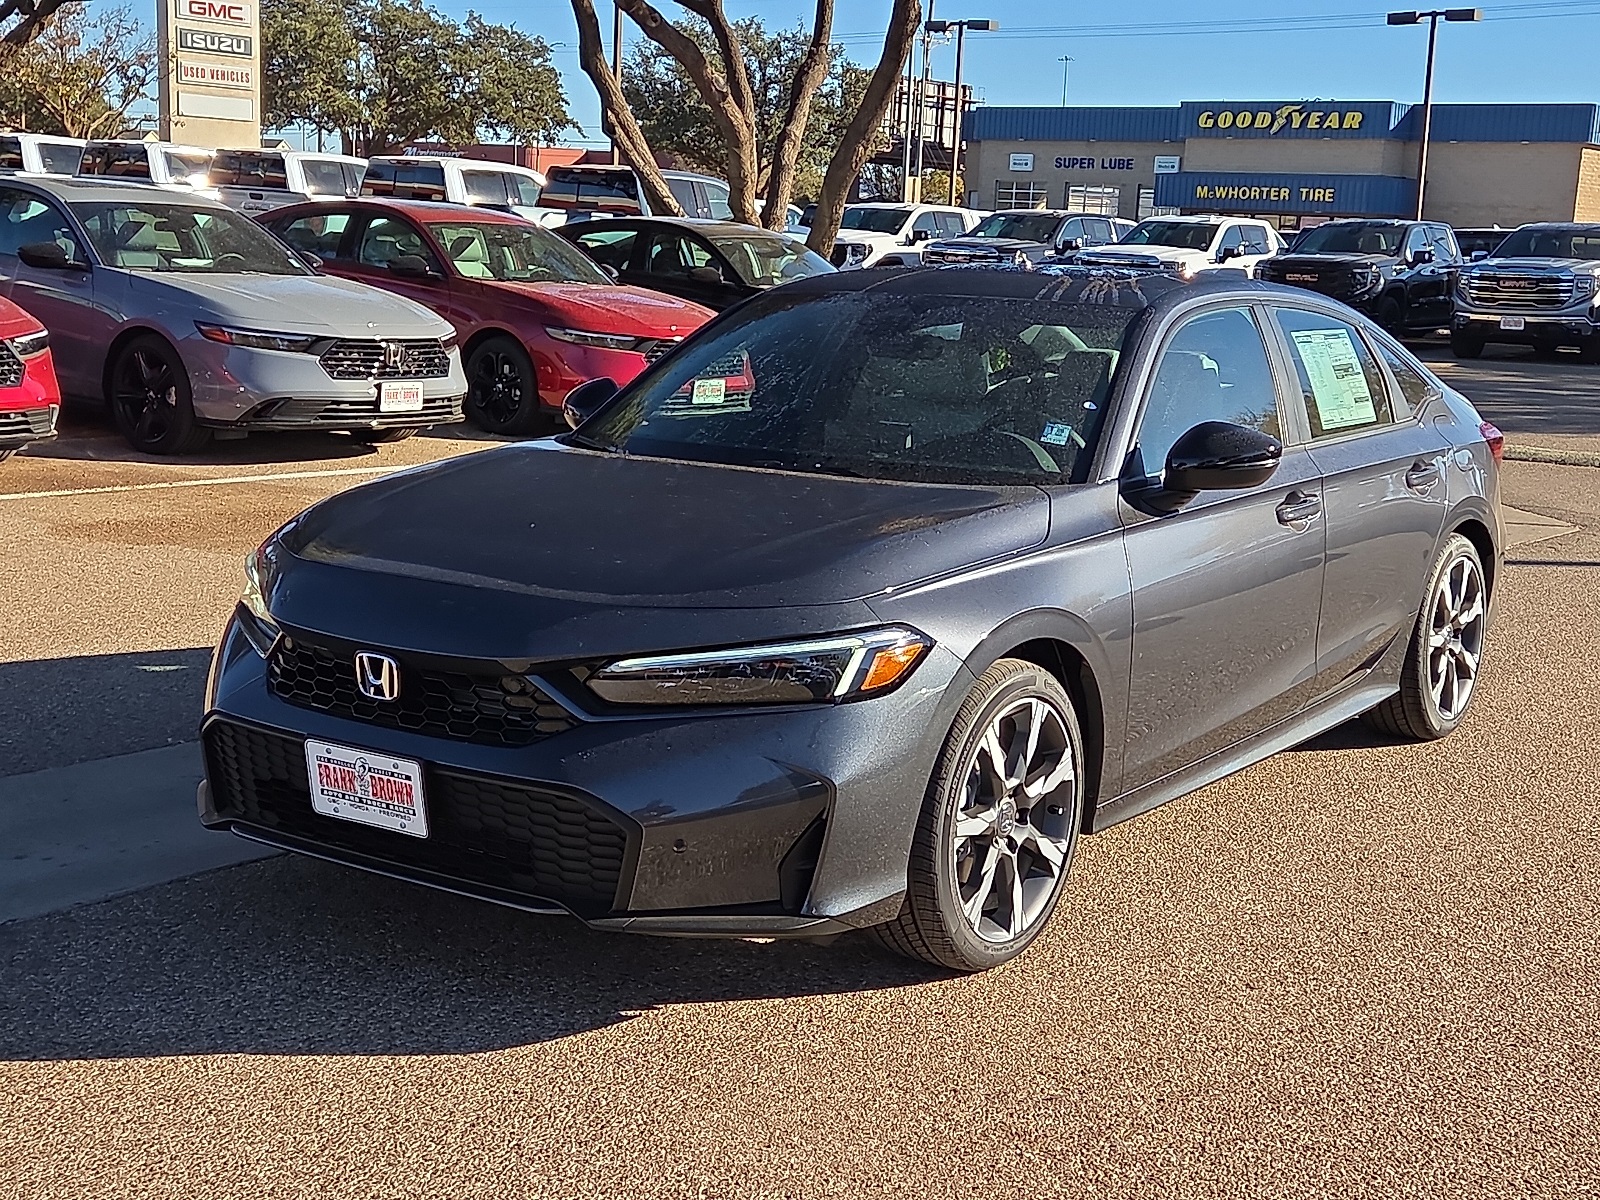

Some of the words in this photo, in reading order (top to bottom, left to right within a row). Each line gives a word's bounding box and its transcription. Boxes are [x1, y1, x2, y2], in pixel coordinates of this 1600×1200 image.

[188, 0, 243, 21] GMC
[186, 33, 244, 53] ISUZU
[183, 66, 206, 79] USED
[209, 69, 250, 84] VEHICLES
[1054, 156, 1096, 170] SUPER
[1100, 158, 1135, 170] LUBE
[1196, 185, 1290, 200] McWHORTER
[1299, 187, 1335, 202] TIRE
[1285, 273, 1319, 282] GMC
[1499, 280, 1537, 288] GMC
[317, 763, 358, 794] FRANK
[369, 775, 415, 808] BROWN
